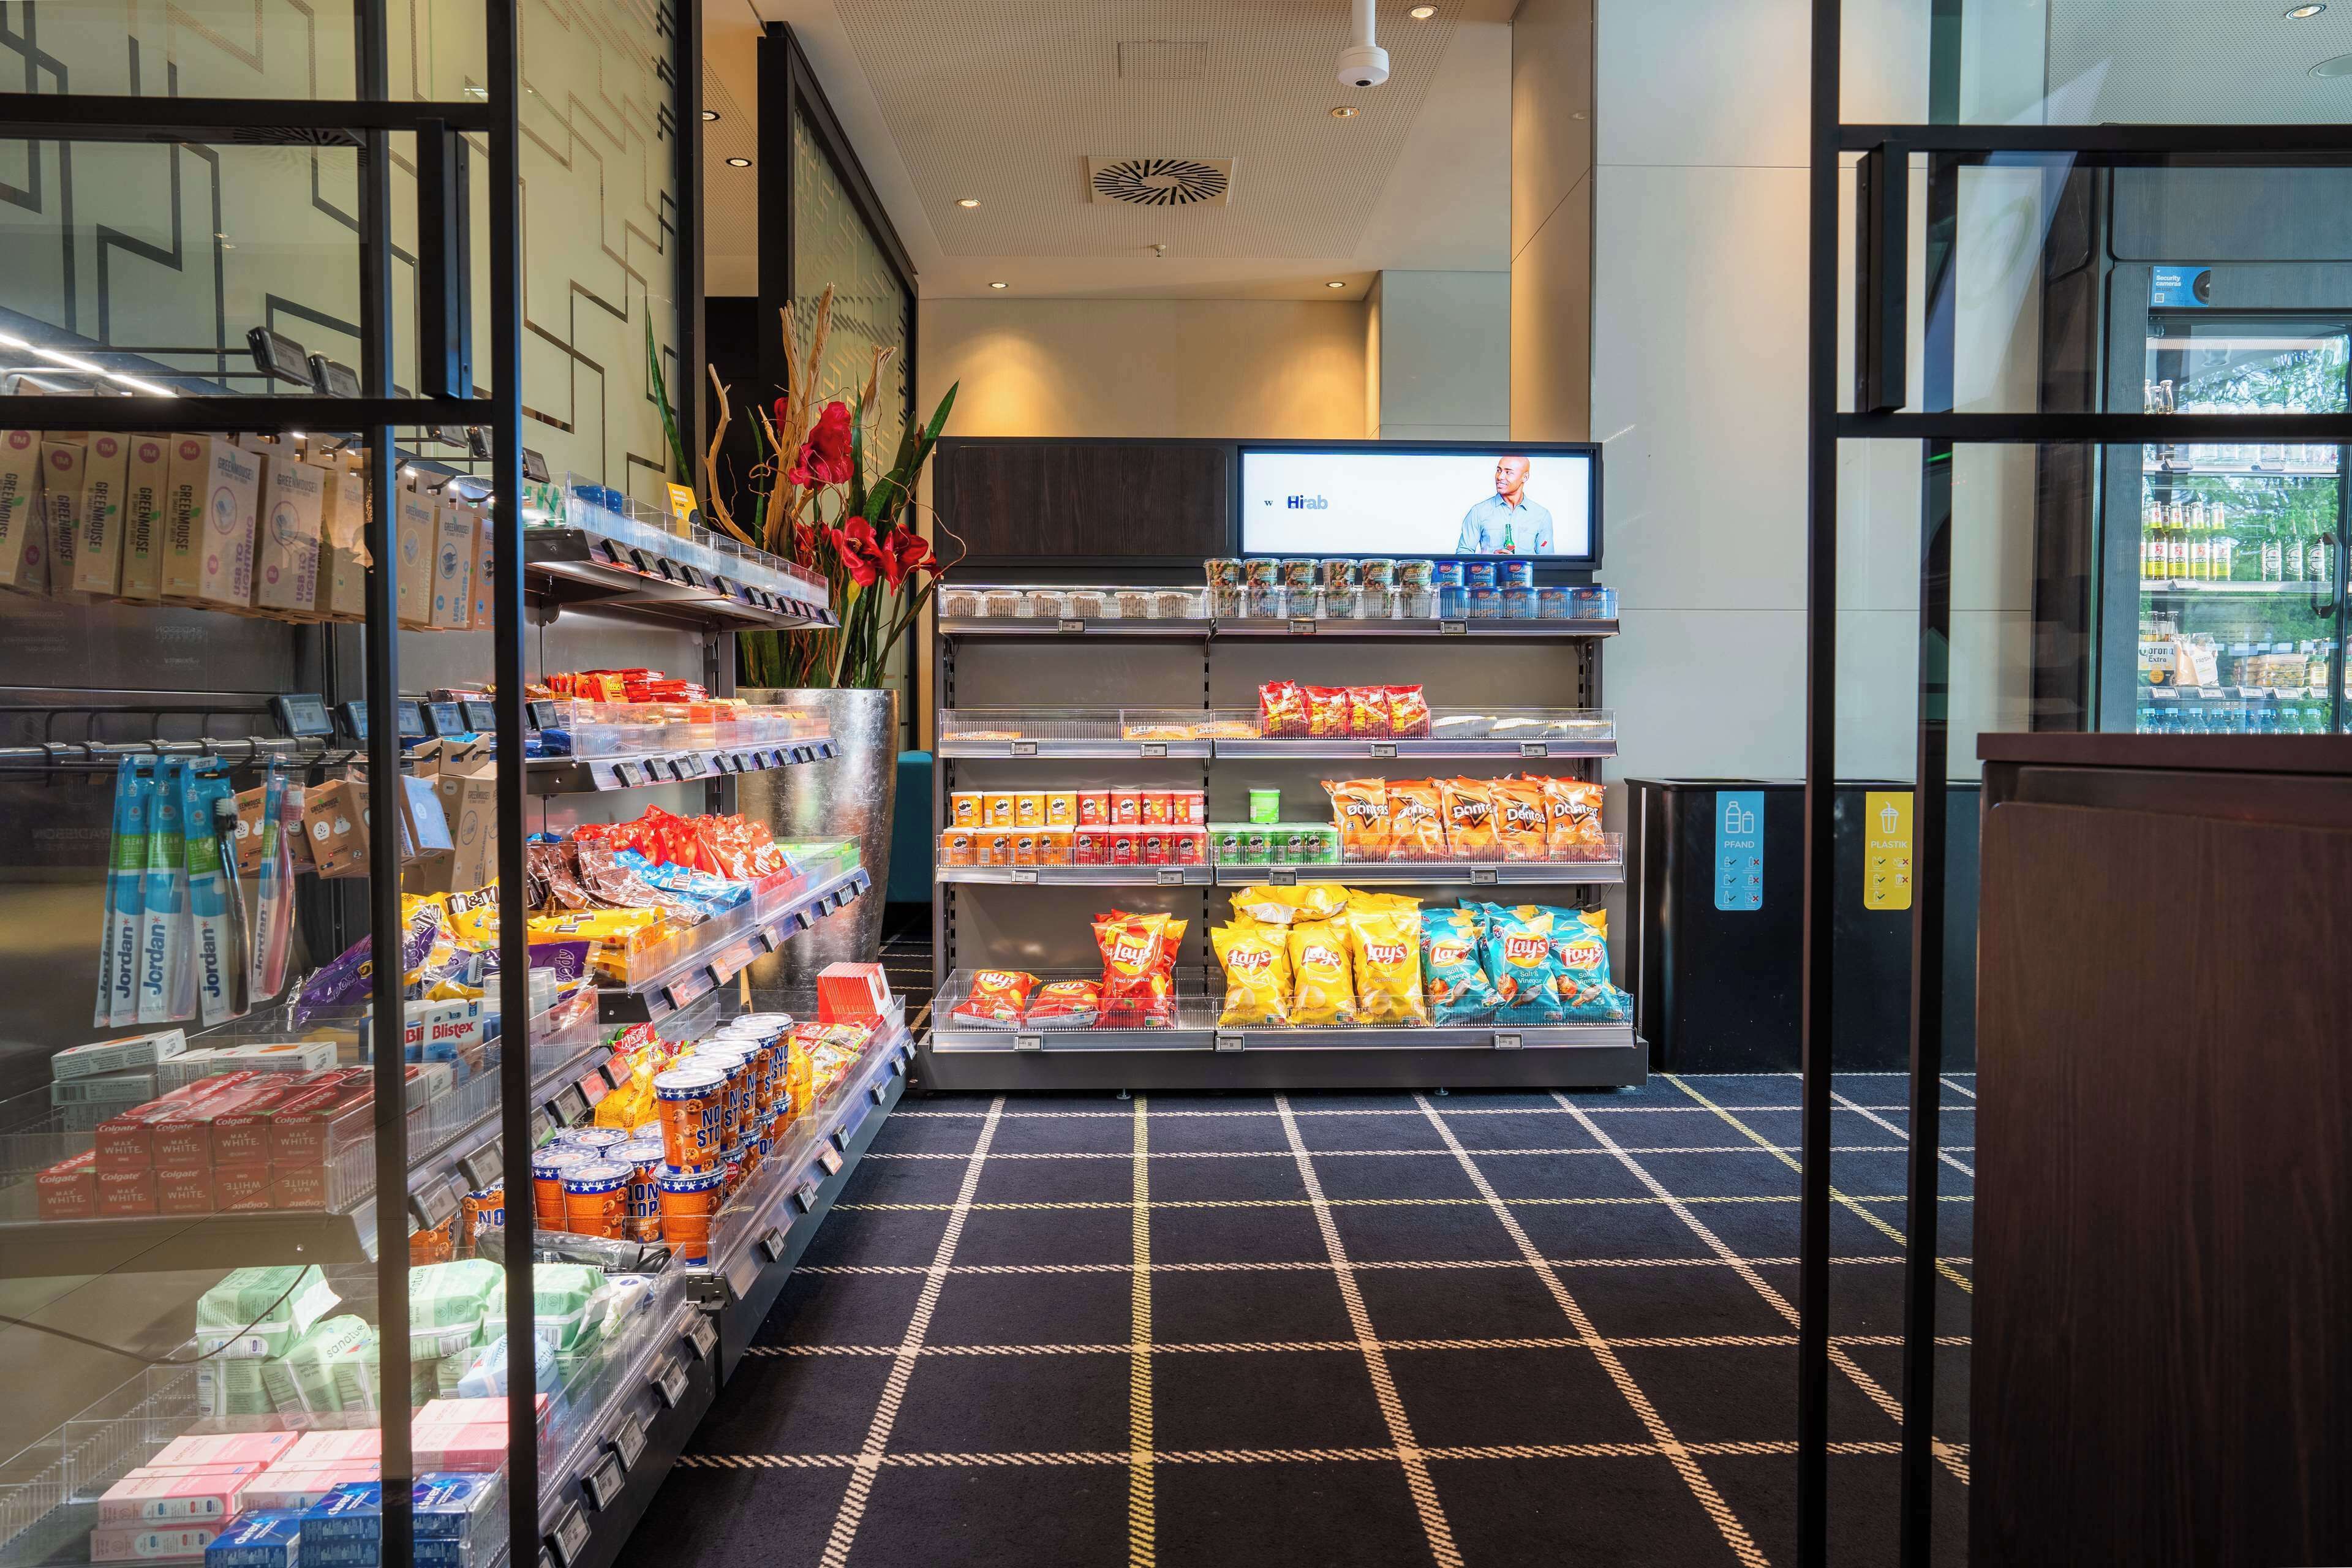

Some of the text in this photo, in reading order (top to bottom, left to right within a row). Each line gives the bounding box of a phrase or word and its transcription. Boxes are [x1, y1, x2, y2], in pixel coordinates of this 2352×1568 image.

[217, 456, 251, 480] GREENMOUSE
[277, 473, 314, 492] GREENMOUSE
[89, 481, 108, 547] GREENMOUSE
[136, 487, 153, 553] GREENMOUSE
[176, 484, 192, 550] GREENMOUSE
[57, 495, 74, 560] GREENMOUSE
[242, 514, 254, 598] LIGHTNING
[306, 526, 318, 603] LIGHTNING
[233, 542, 244, 596] USB TO
[296, 551, 307, 601] USB TO
[2139, 646, 2174, 657] Corona
[239, 797, 262, 809] EENMOUSE
[1507, 808, 1545, 824] Doritos
[255, 910, 268, 977] Jordan
[1367, 943, 1405, 965] Lay's
[1507, 938, 1547, 960] Lay's
[116, 926, 134, 999] Jordan
[143, 924, 166, 996] Jordan
[203, 928, 221, 998] Jordan
[556, 949, 575, 981] Body
[1113, 942, 1152, 967] Lay's
[1228, 949, 1272, 971] Lay's
[1303, 946, 1340, 967] Lay's
[1562, 943, 1604, 969] Lay's
[432, 1021, 475, 1040] Blistex
[99, 1124, 137, 1134] Colgate
[156, 1123, 195, 1133] Colgate
[216, 1117, 253, 1127] Colgate
[274, 1115, 312, 1125] Colgate
[162, 1144, 200, 1153] WHITE
[222, 1138, 258, 1147] WHITE
[281, 1137, 317, 1146] WHITE
[39, 1174, 78, 1184] Colgate
[101, 1172, 140, 1182] Colgate
[160, 1170, 199, 1180] Colgate
[224, 1180, 261, 1191] WHITE
[282, 1179, 320, 1188] WHITE
[47, 1195, 85, 1205] WHITE
[168, 1191, 205, 1199] WHITE
[232, 1201, 270, 1210] Colgate
[288, 1199, 326, 1208] Colgate
[327, 1493, 355, 1515] durex
[418, 1486, 443, 1510] durex
[233, 1523, 264, 1545] durex
